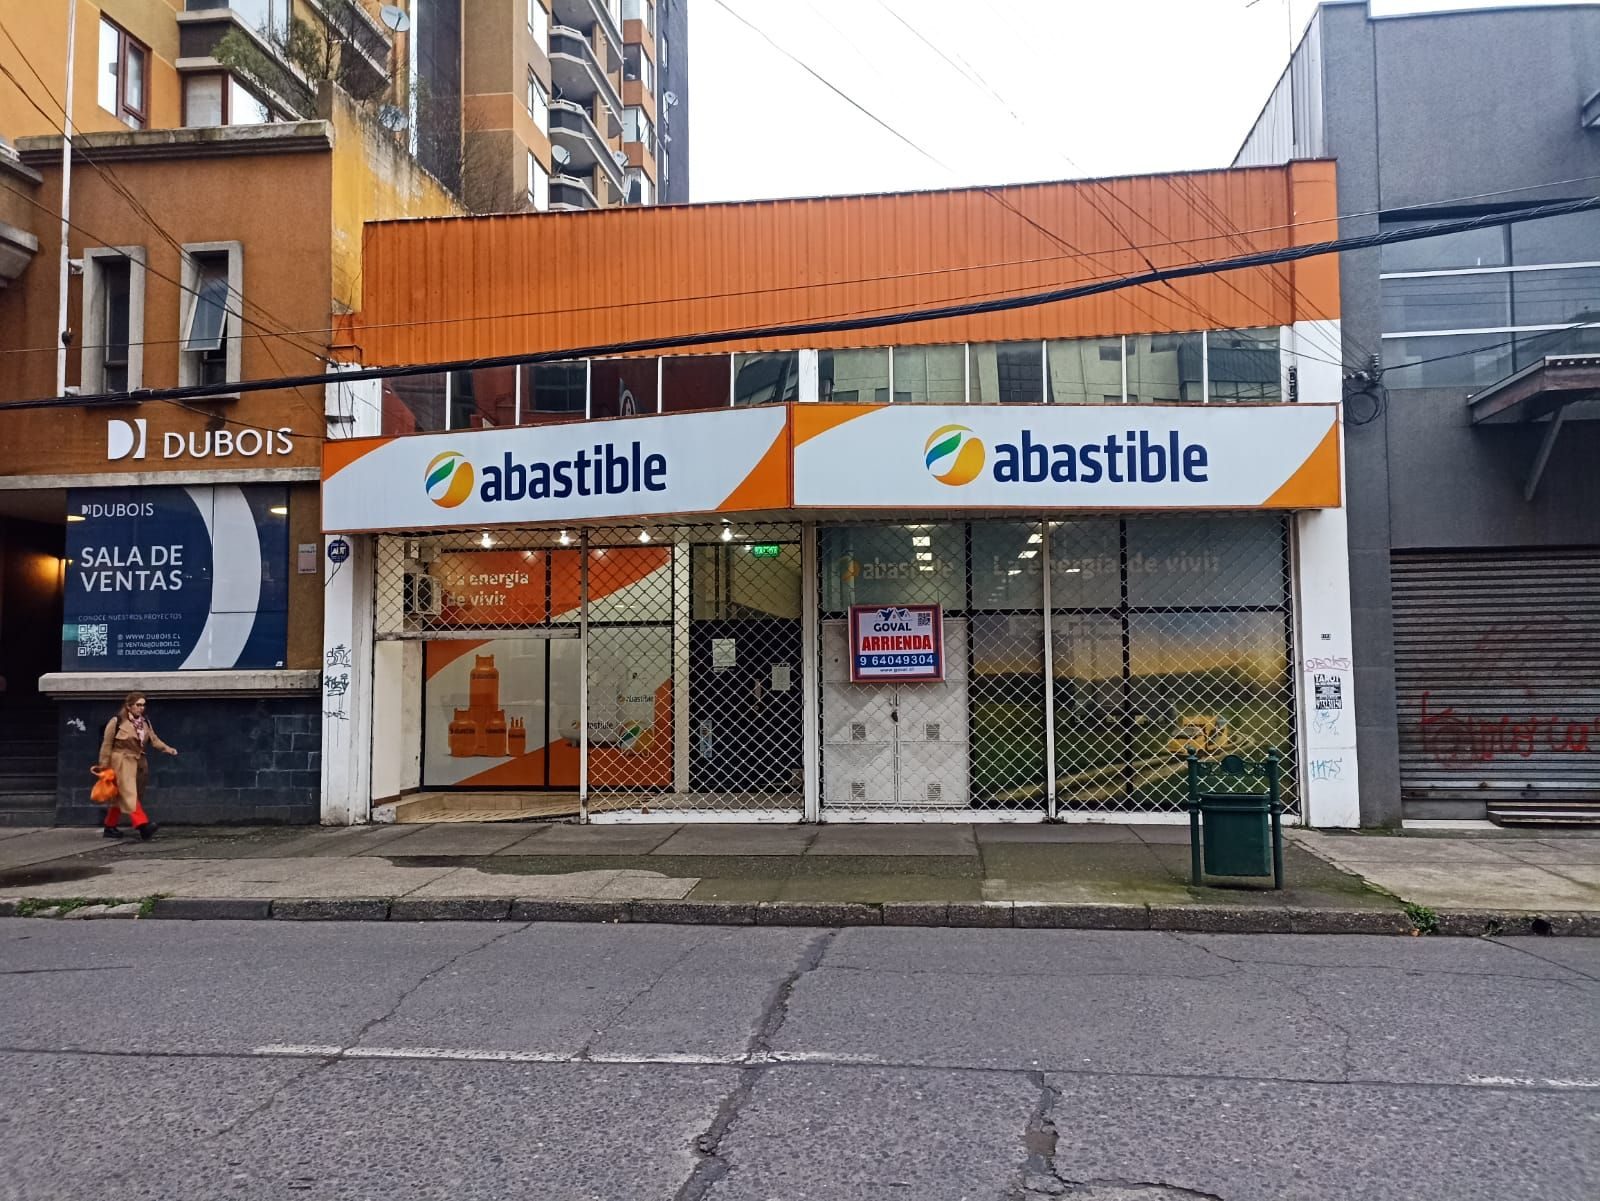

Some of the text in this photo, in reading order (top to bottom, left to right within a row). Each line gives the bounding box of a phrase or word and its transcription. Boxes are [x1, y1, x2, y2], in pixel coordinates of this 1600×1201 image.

[163, 428, 293, 459] DUBOIS
[993, 430, 1208, 483] abastible
[480, 441, 667, 503] abastible
[92, 503, 154, 517] DUBOIS
[81, 545, 183, 568] SALA DE
[1129, 553, 1159, 573] de
[80, 570, 183, 592] VENTAS
[470, 590, 507, 606] vivir
[873, 622, 912, 632] GOVAL
[861, 635, 932, 651] ARRIENDA
[859, 655, 934, 666] 9 64049304
